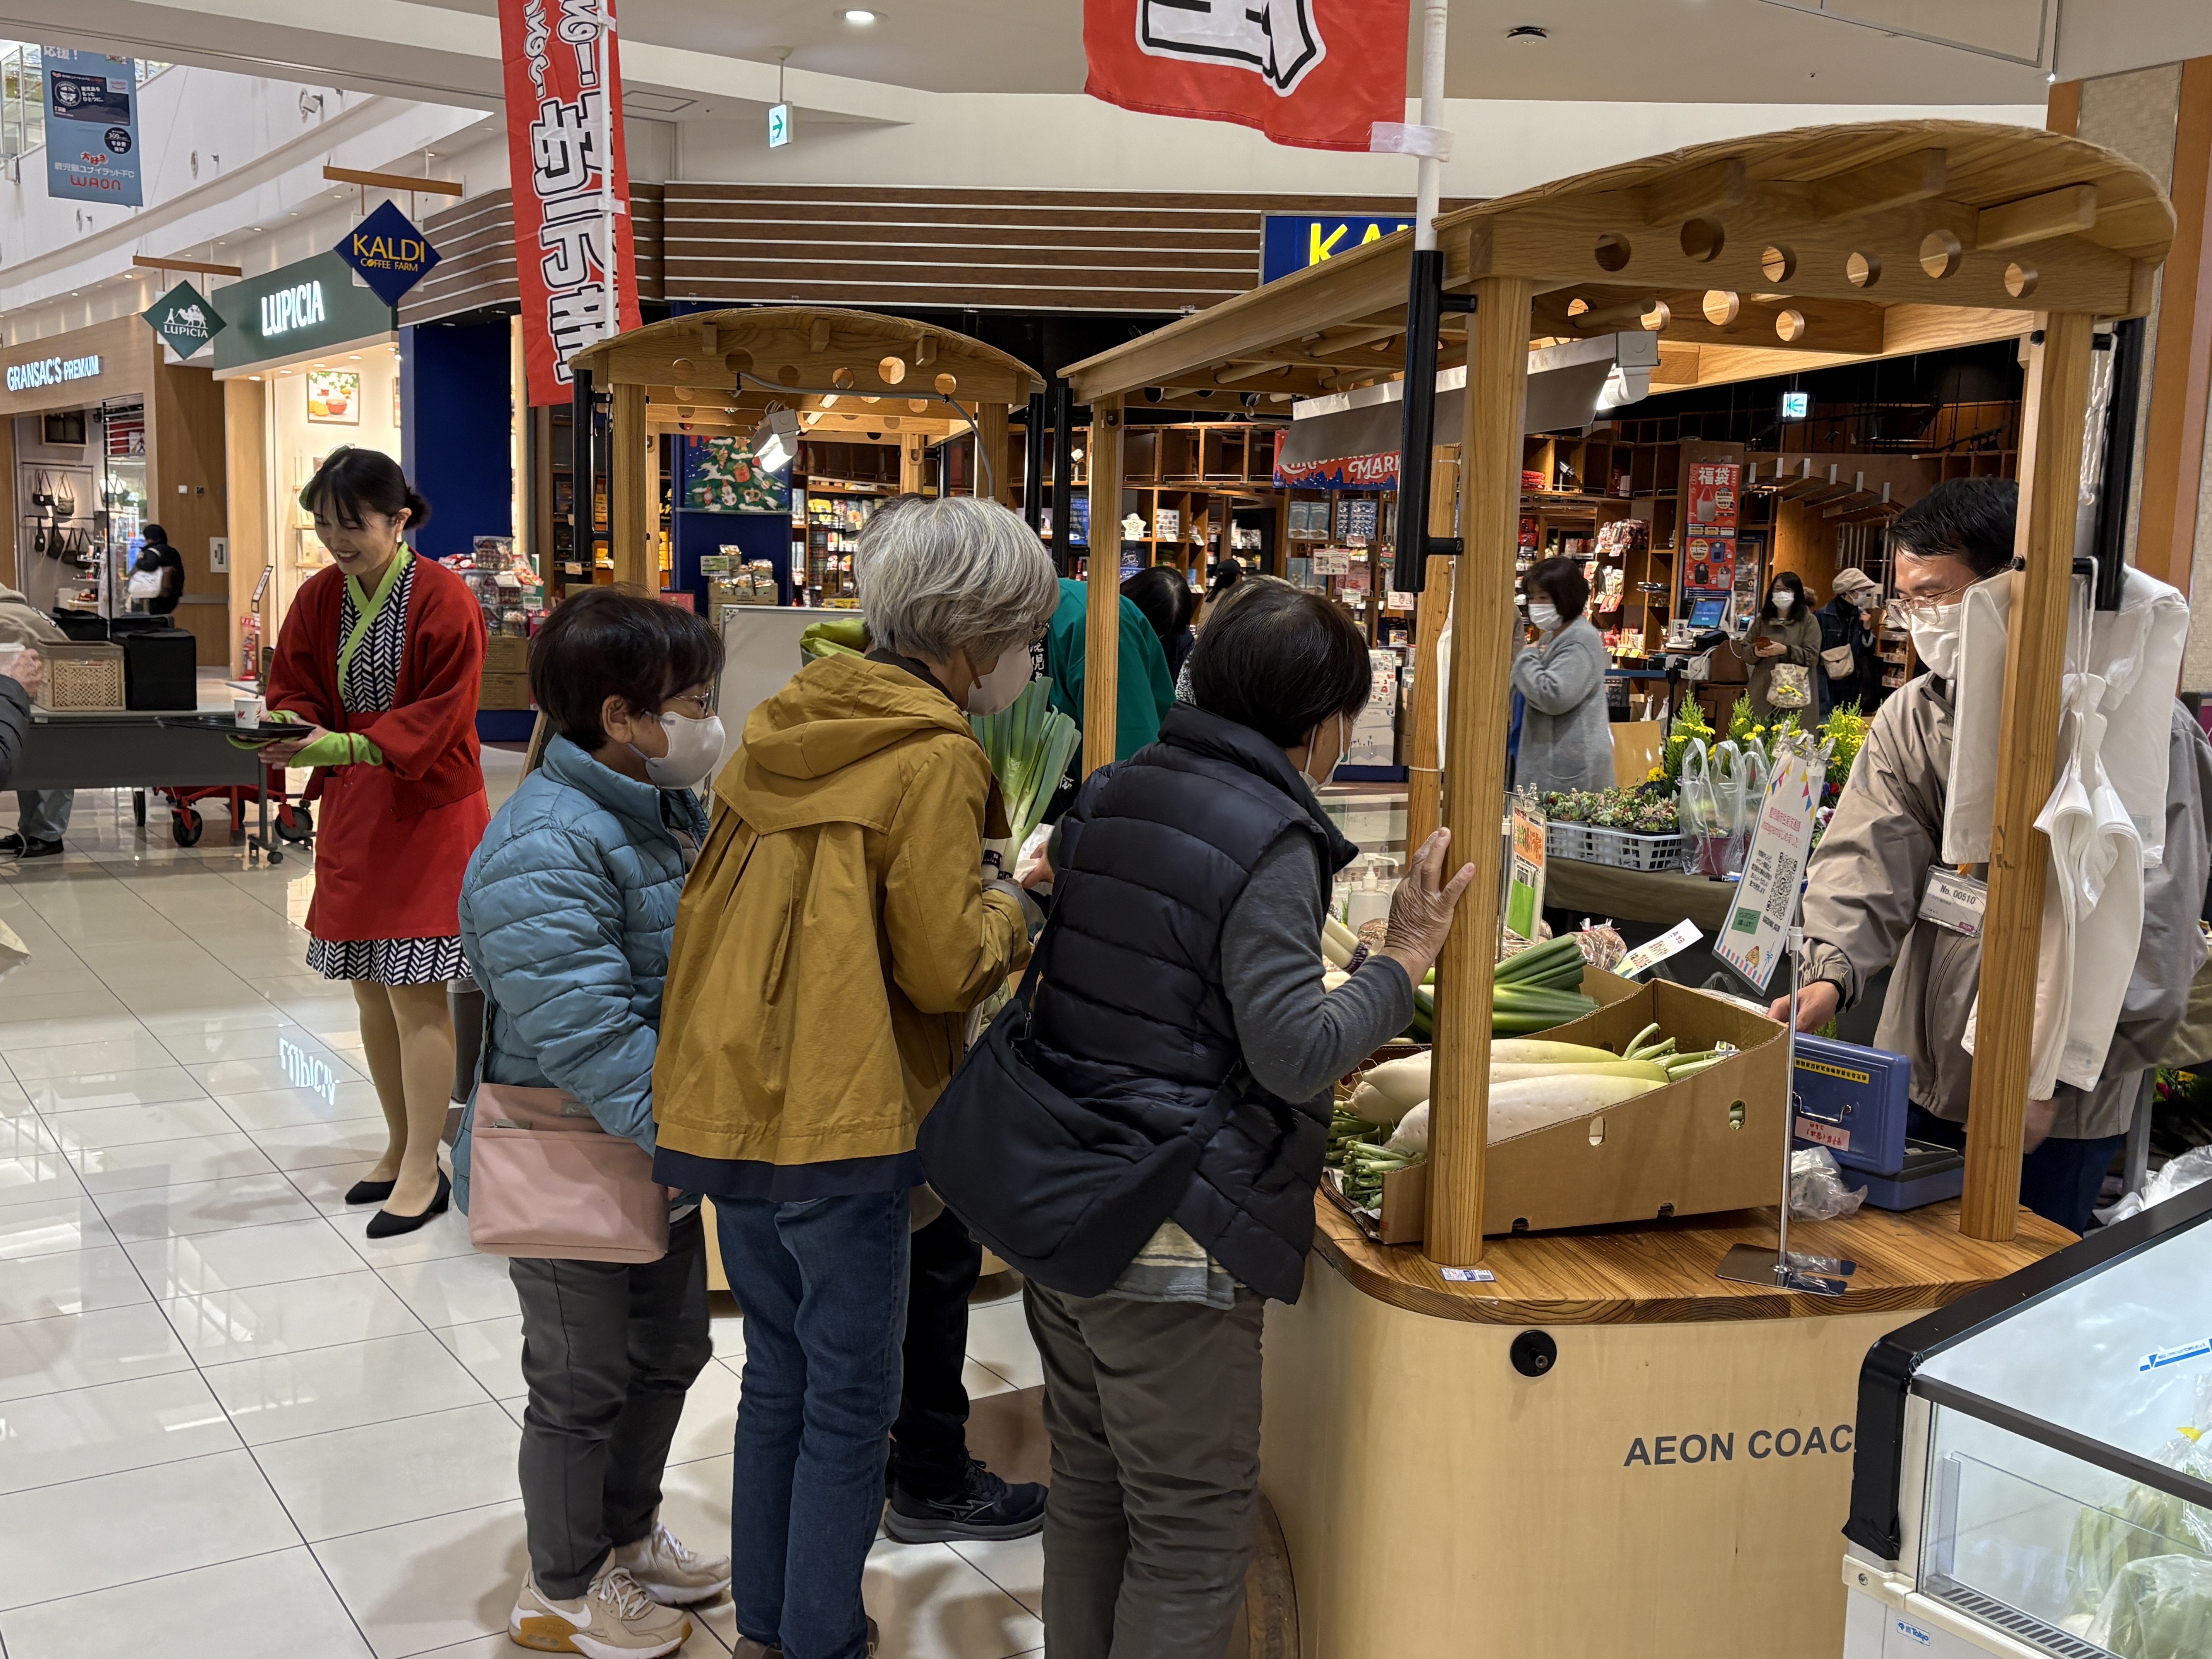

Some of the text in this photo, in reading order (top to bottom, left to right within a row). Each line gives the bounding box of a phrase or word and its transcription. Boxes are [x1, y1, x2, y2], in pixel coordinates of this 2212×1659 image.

[70, 174, 122, 191] WAON
[353, 233, 425, 263] KALDI
[360, 258, 418, 272] COFFEE FARM
[261, 280, 325, 337] LUPICIA
[163, 325, 209, 338] LUPICIA
[7, 355, 100, 392] GRANSAC'S PREMIUM
[1698, 467, 1730, 486] 福袋
[1953, 890, 1976, 905] 00510
[1623, 1432, 1734, 1467] AEON
